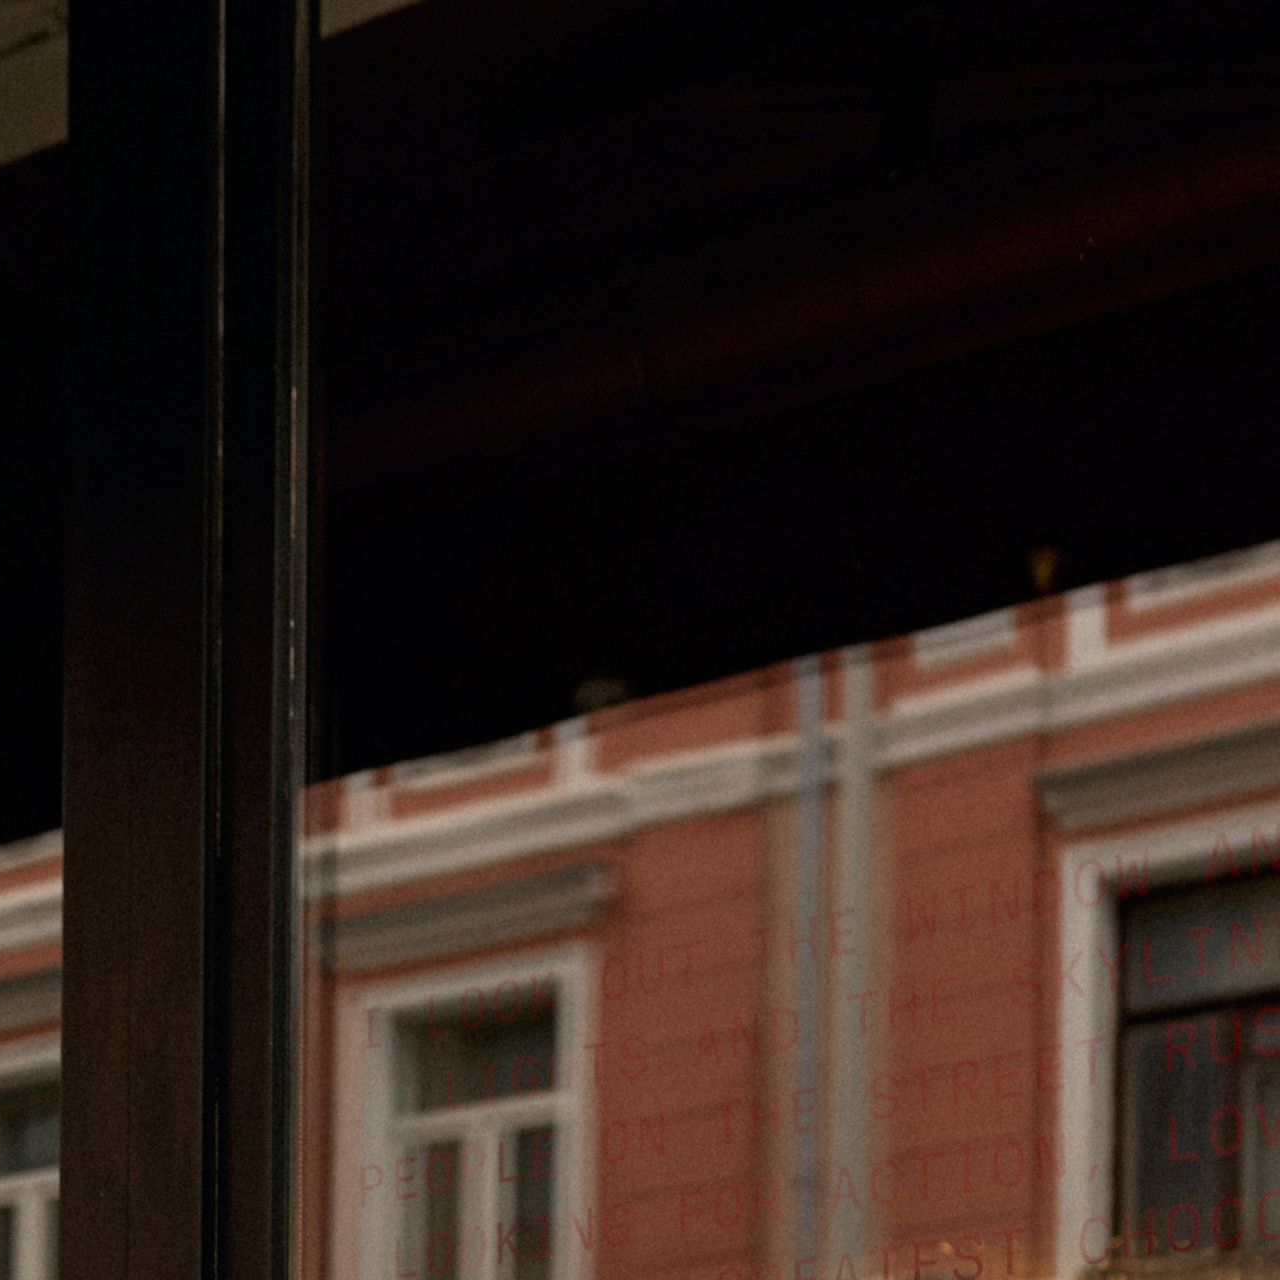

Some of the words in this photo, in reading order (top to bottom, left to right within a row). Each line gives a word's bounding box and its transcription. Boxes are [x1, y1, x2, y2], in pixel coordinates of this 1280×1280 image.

[426, 970, 556, 1038] LOOK
[601, 938, 702, 1003] OUT
[751, 908, 856, 973] THE
[904, 850, 1150, 943] WINDOW
[693, 1005, 800, 1068] AND
[847, 974, 960, 1037] THE
[1010, 913, 1280, 1010] SKYLIN
[361, 1131, 557, 1207] PEOPLE
[601, 1113, 667, 1167] ON
[711, 1084, 820, 1147] THE
[869, 1033, 1111, 1122] STREET
[394, 1201, 632, 1280] LOOKING
[678, 1177, 781, 1237] FOR
[830, 1130, 1099, 1213] ACTION,
